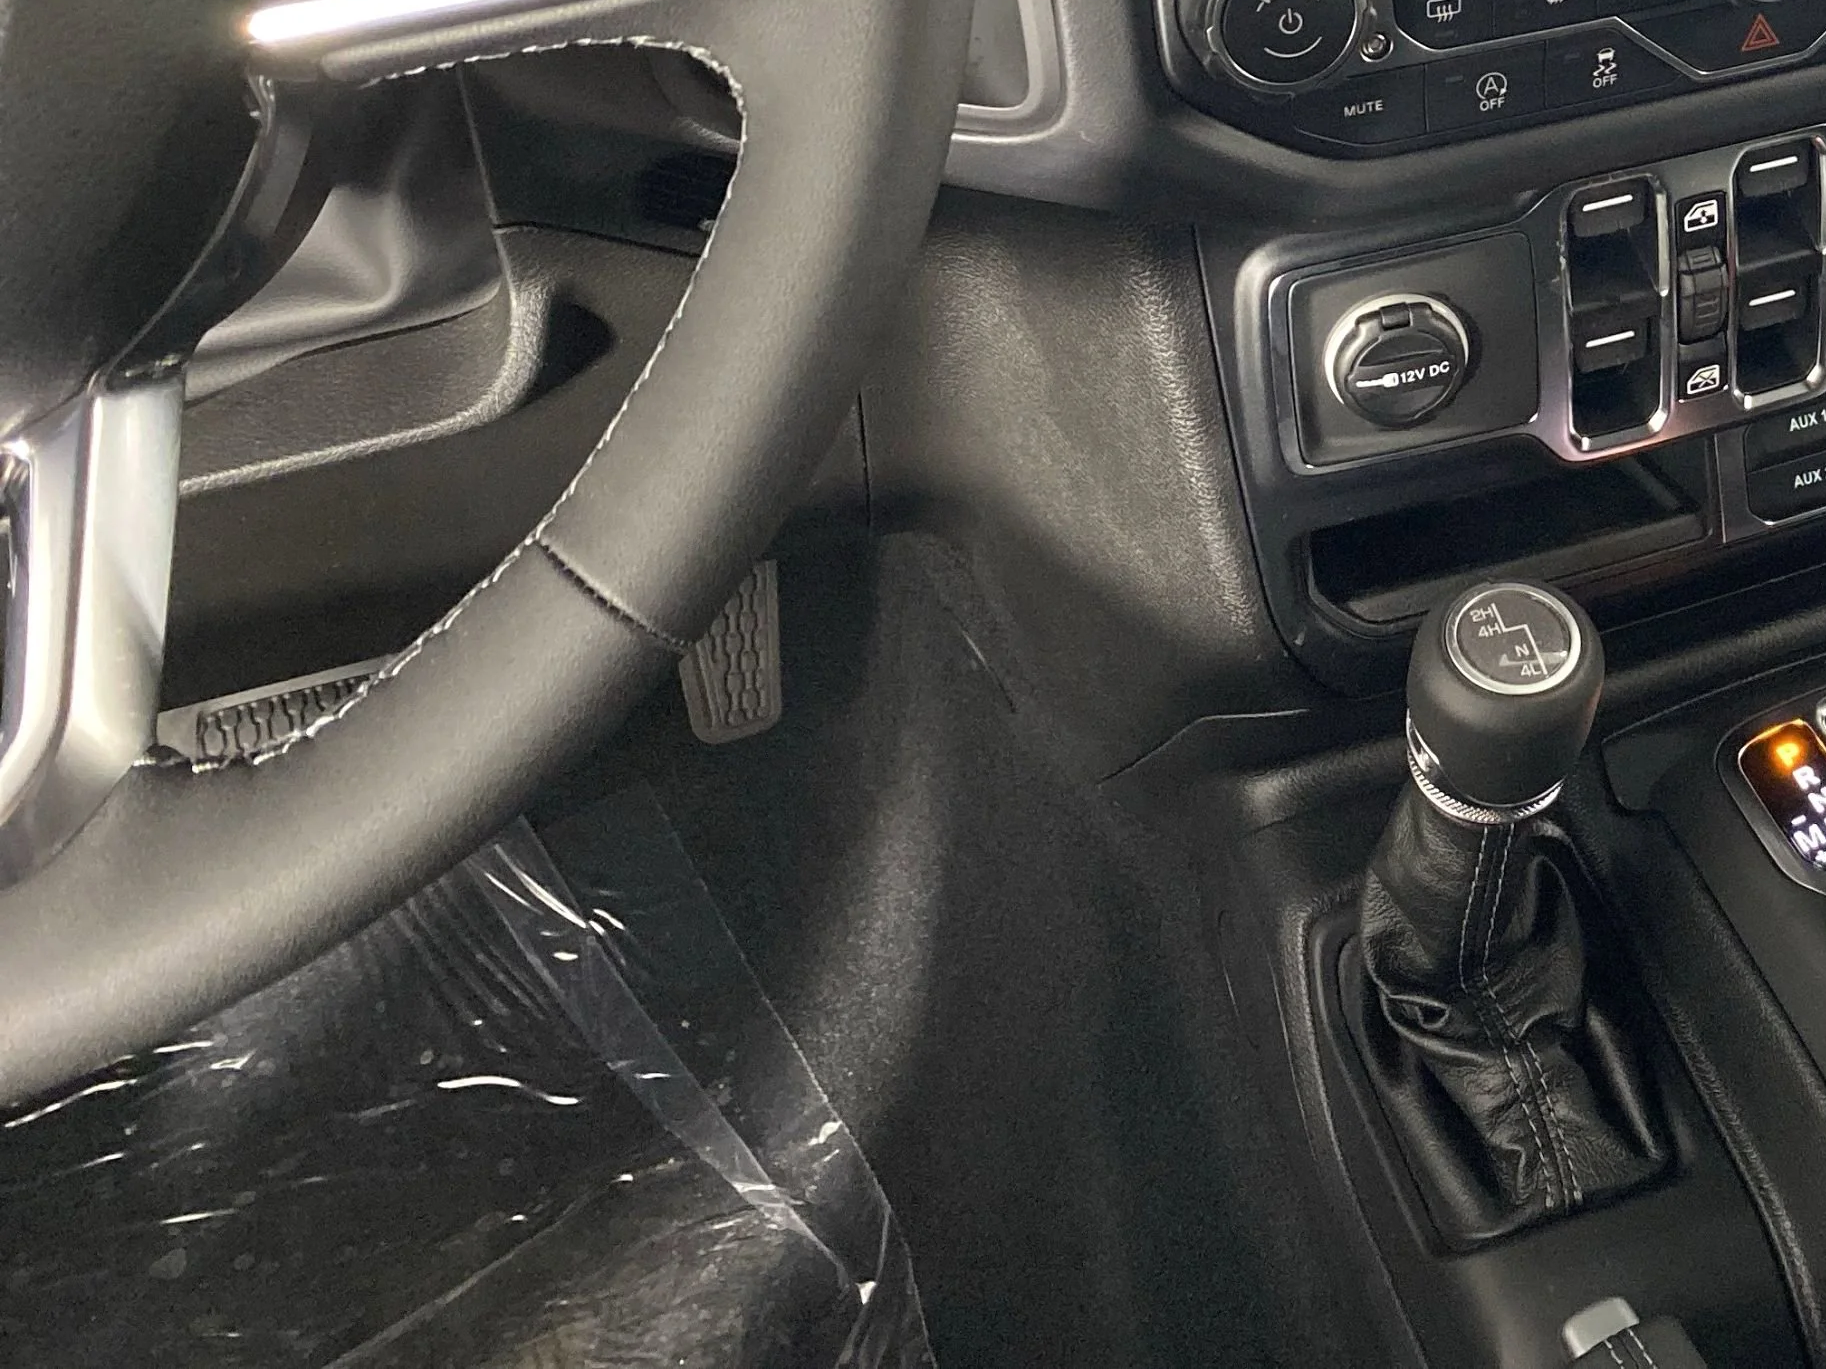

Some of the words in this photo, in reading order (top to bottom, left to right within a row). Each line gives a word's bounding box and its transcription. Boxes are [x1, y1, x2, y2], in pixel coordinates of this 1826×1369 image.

[1592, 72, 1618, 89] OFF
[1343, 98, 1384, 117] MUTE
[1479, 95, 1505, 113] OFF
[1400, 367, 1426, 384] 12V
[1429, 361, 1451, 378] DC
[1789, 411, 1818, 432] AUX
[1794, 468, 1822, 489] AUX
[1470, 604, 1493, 623] 2H
[1477, 620, 1502, 638] 4H
[1516, 642, 1531, 658] N
[1520, 660, 1542, 679] 4L
[1779, 742, 1800, 768] P
[1792, 764, 1822, 794] R
[1793, 823, 1826, 853] M
